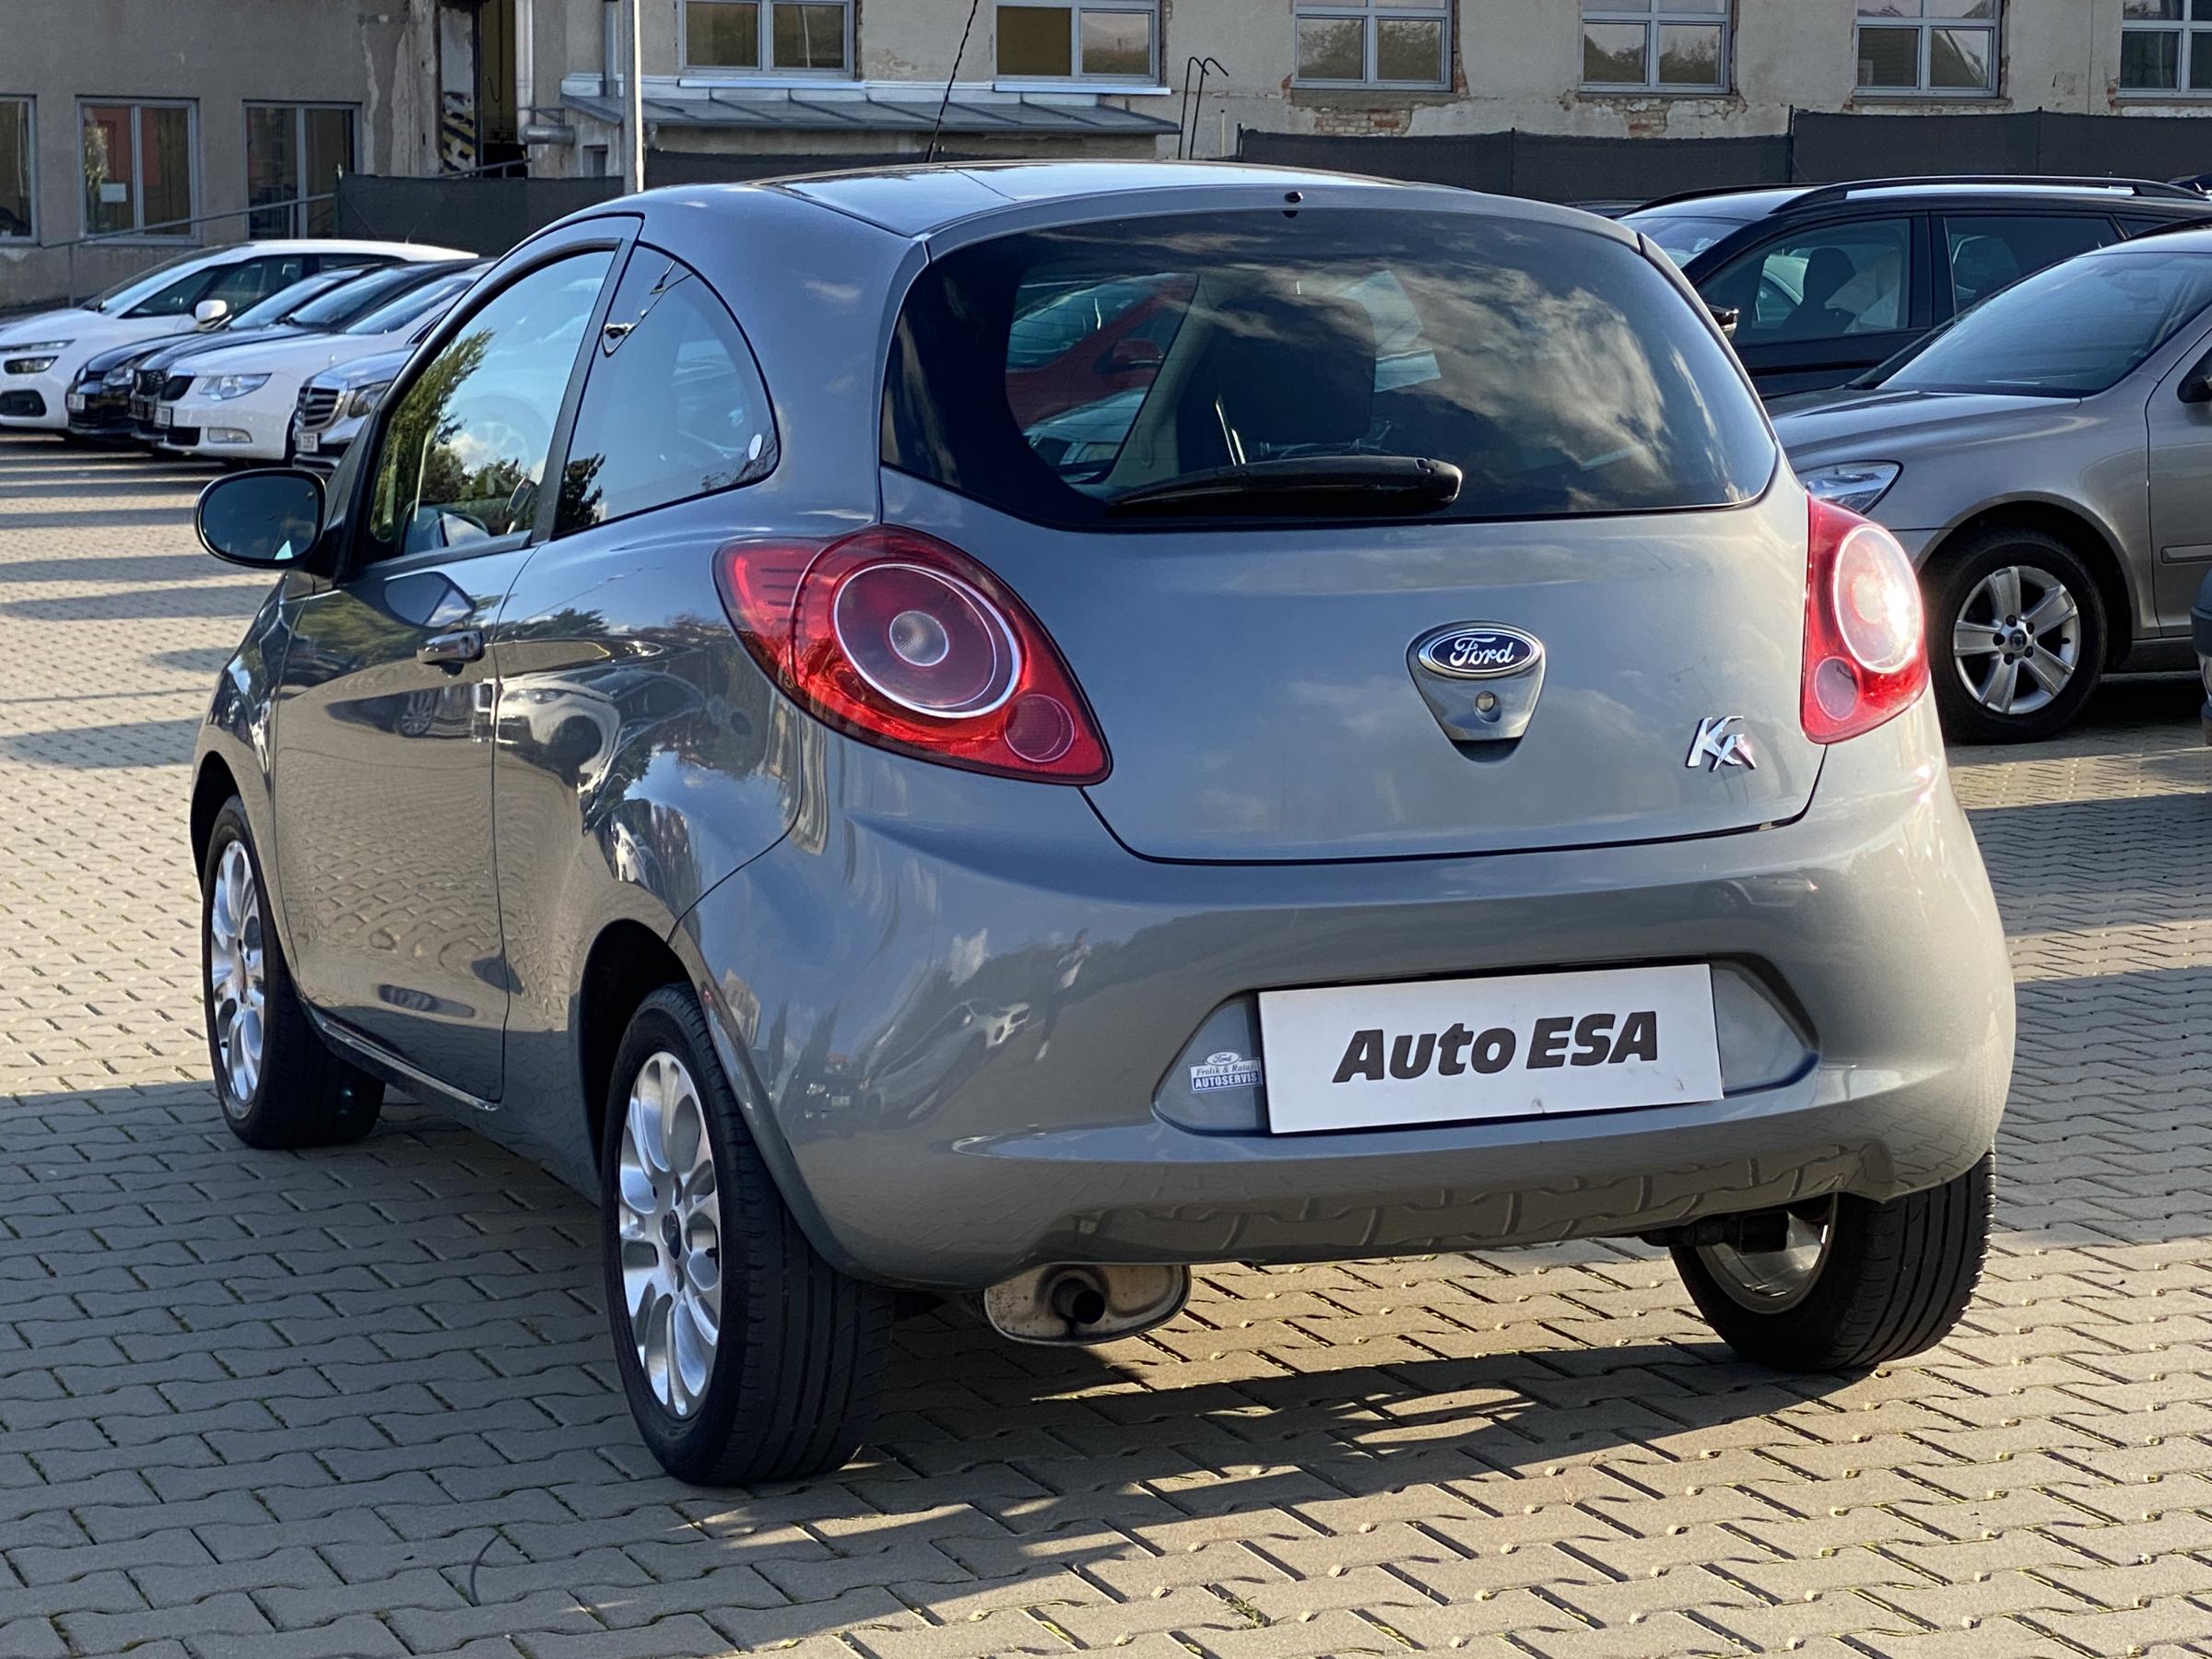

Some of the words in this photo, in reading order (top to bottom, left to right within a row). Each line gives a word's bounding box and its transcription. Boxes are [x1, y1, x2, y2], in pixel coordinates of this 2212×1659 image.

[1449, 637, 1514, 666] Ford
[1685, 715, 1757, 771] Ka
[1332, 1023, 1516, 1083] Auto
[1526, 1011, 1657, 1069] ESA
[1194, 1072, 1257, 1088] AUTOSERVIS
